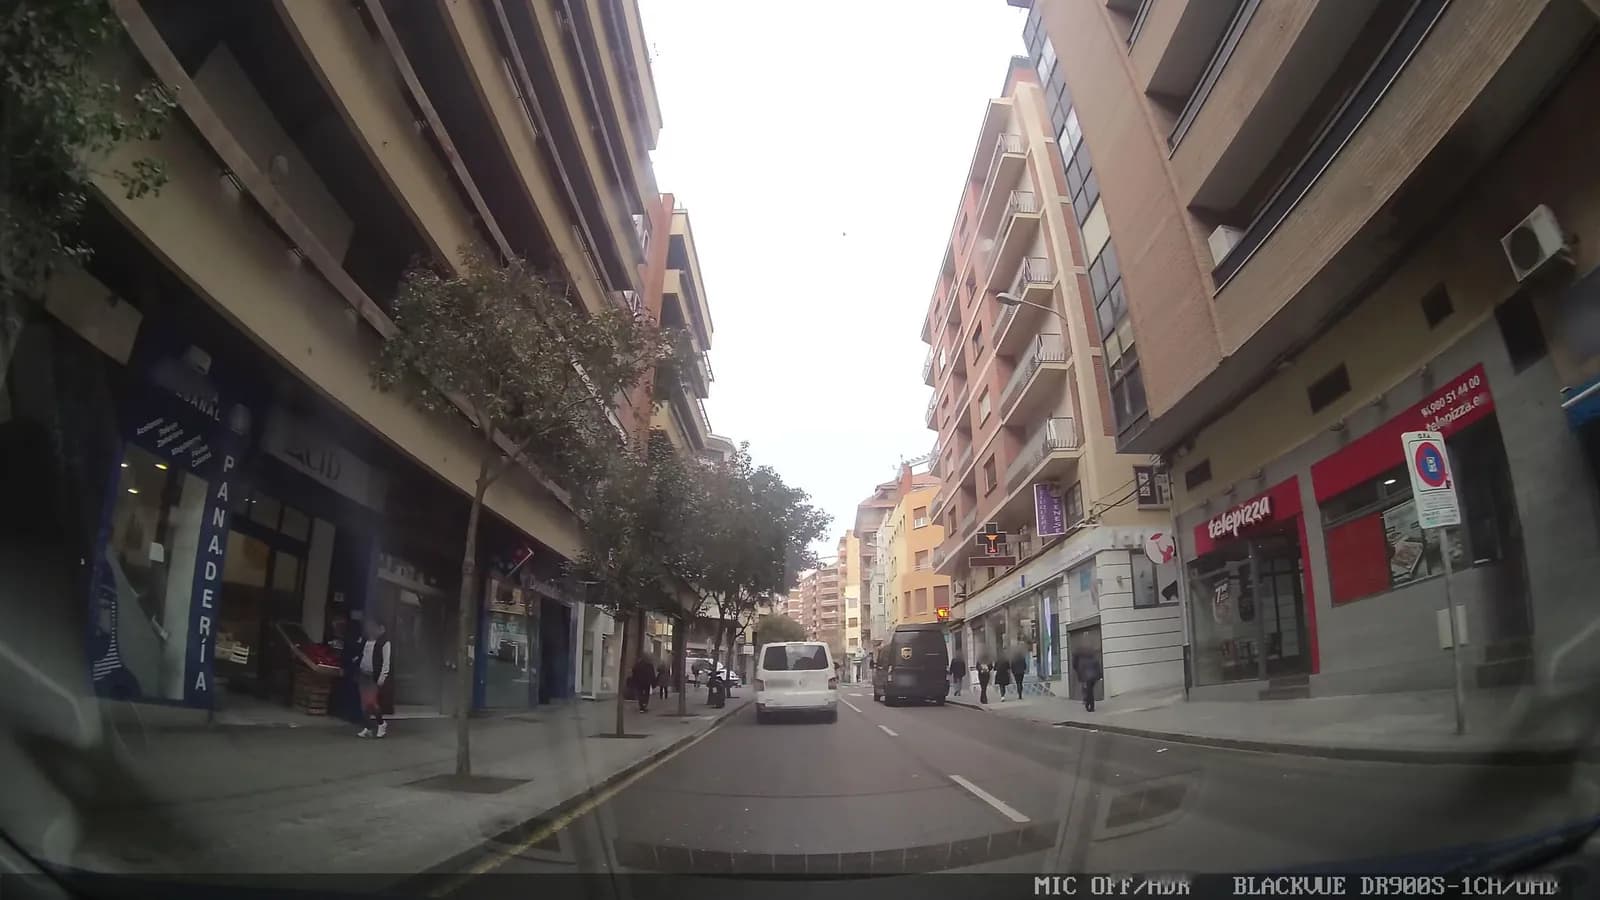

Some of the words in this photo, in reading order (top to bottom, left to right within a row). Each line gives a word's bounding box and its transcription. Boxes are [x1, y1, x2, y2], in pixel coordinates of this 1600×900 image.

[1469, 375, 1480, 389] 00
[1426, 393, 1487, 432] telepizza.e
[1208, 496, 1270, 538] telepizza
[195, 456, 235, 691] PANADERÍA
